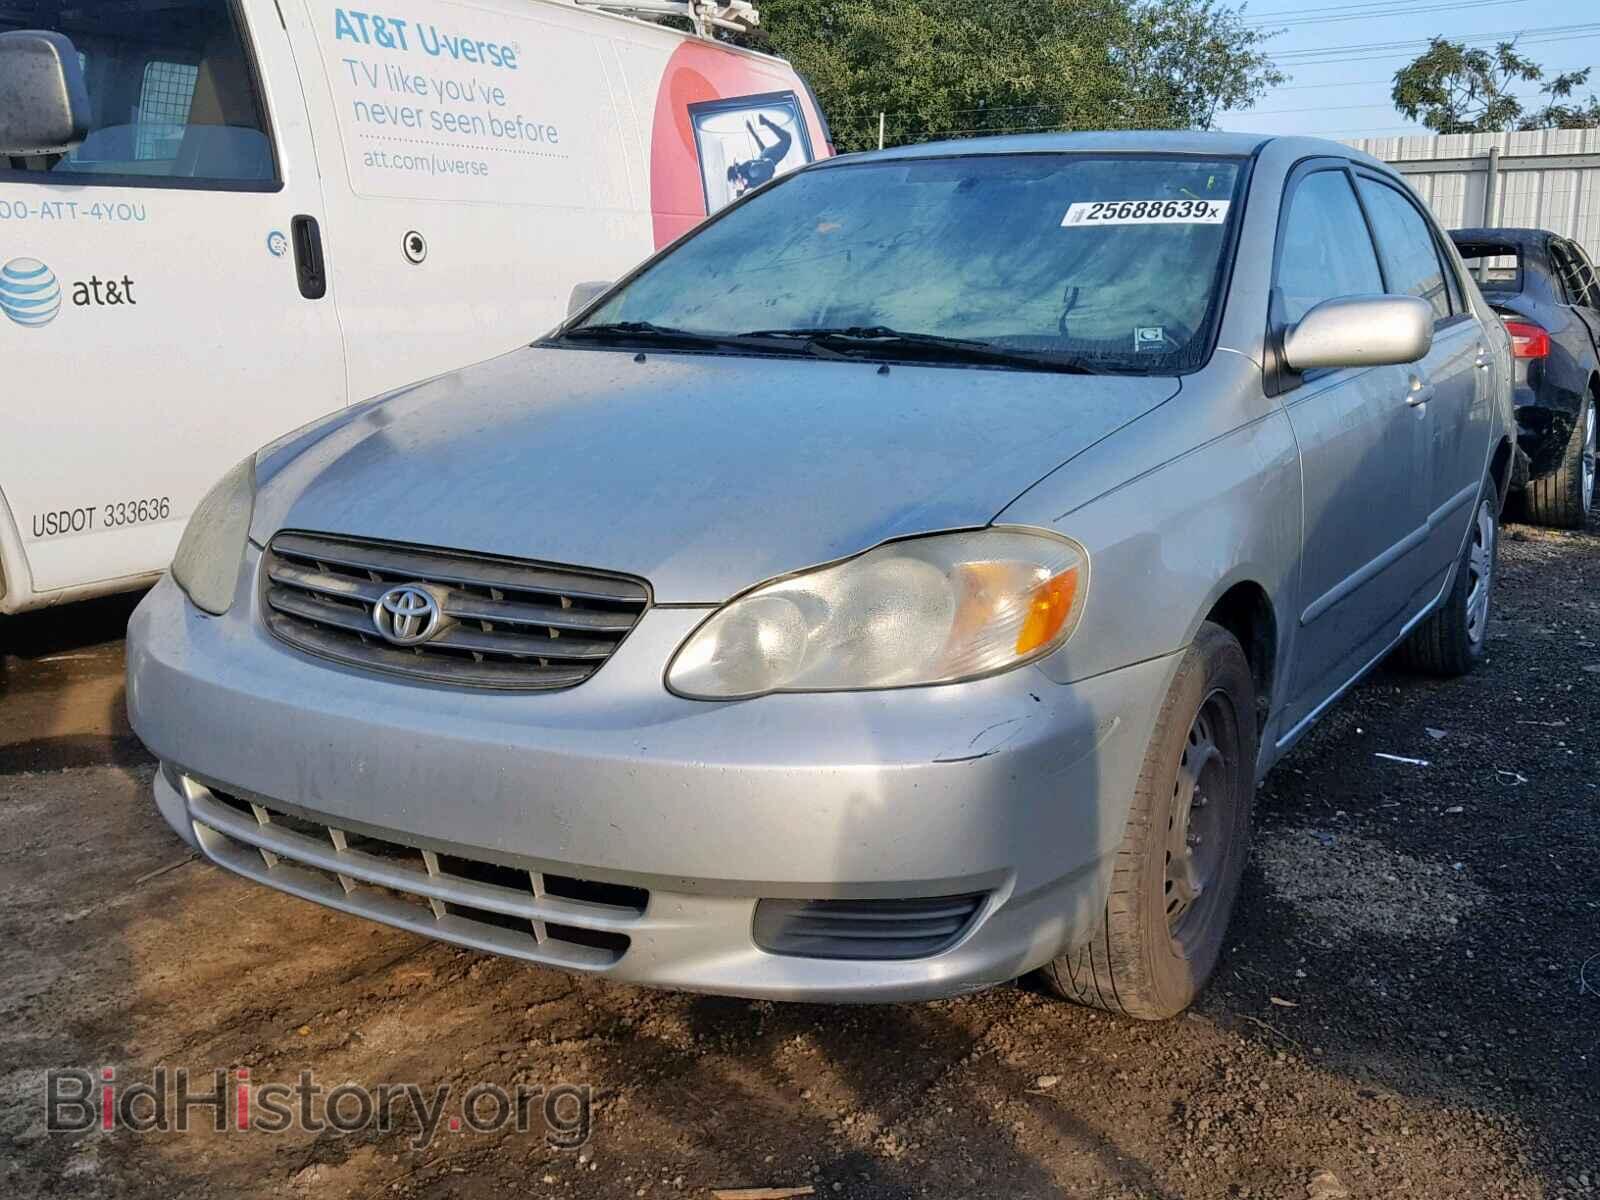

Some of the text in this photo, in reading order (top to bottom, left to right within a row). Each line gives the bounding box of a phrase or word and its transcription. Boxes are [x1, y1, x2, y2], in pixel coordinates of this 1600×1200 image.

[335, 8, 408, 51] AT&T
[342, 58, 506, 106] TV like you've
[353, 100, 559, 144] never seen before
[363, 149, 489, 176] att.com/uverse
[72, 274, 137, 306] at&t
[32, 496, 170, 538] USDOT 333636
